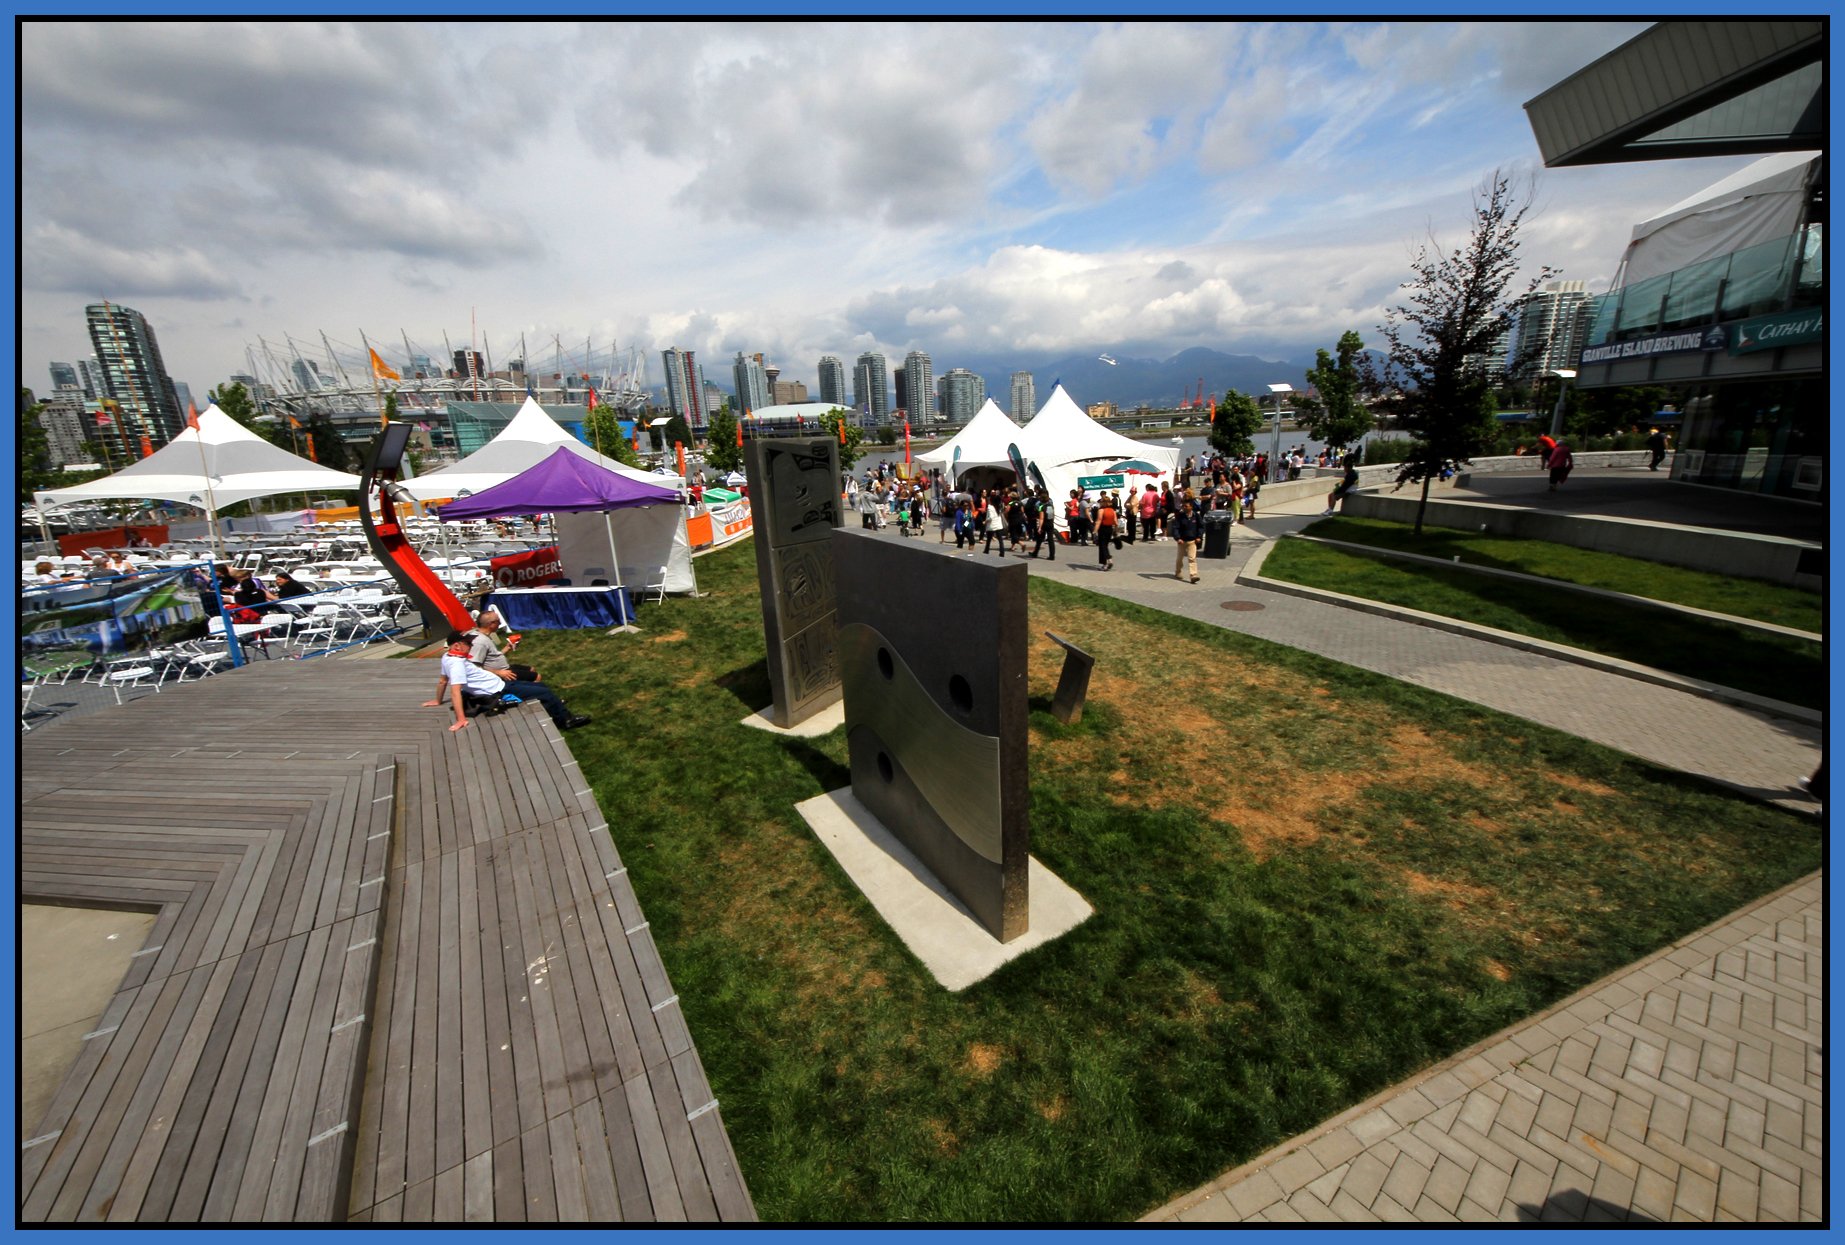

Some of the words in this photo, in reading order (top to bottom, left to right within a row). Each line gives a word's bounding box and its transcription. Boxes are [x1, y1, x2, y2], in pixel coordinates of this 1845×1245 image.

[1758, 320, 1815, 340] CATHAY
[1582, 344, 1621, 362] GRANVILLE
[1622, 339, 1653, 357] ISLAND
[1652, 332, 1702, 352] BREWING
